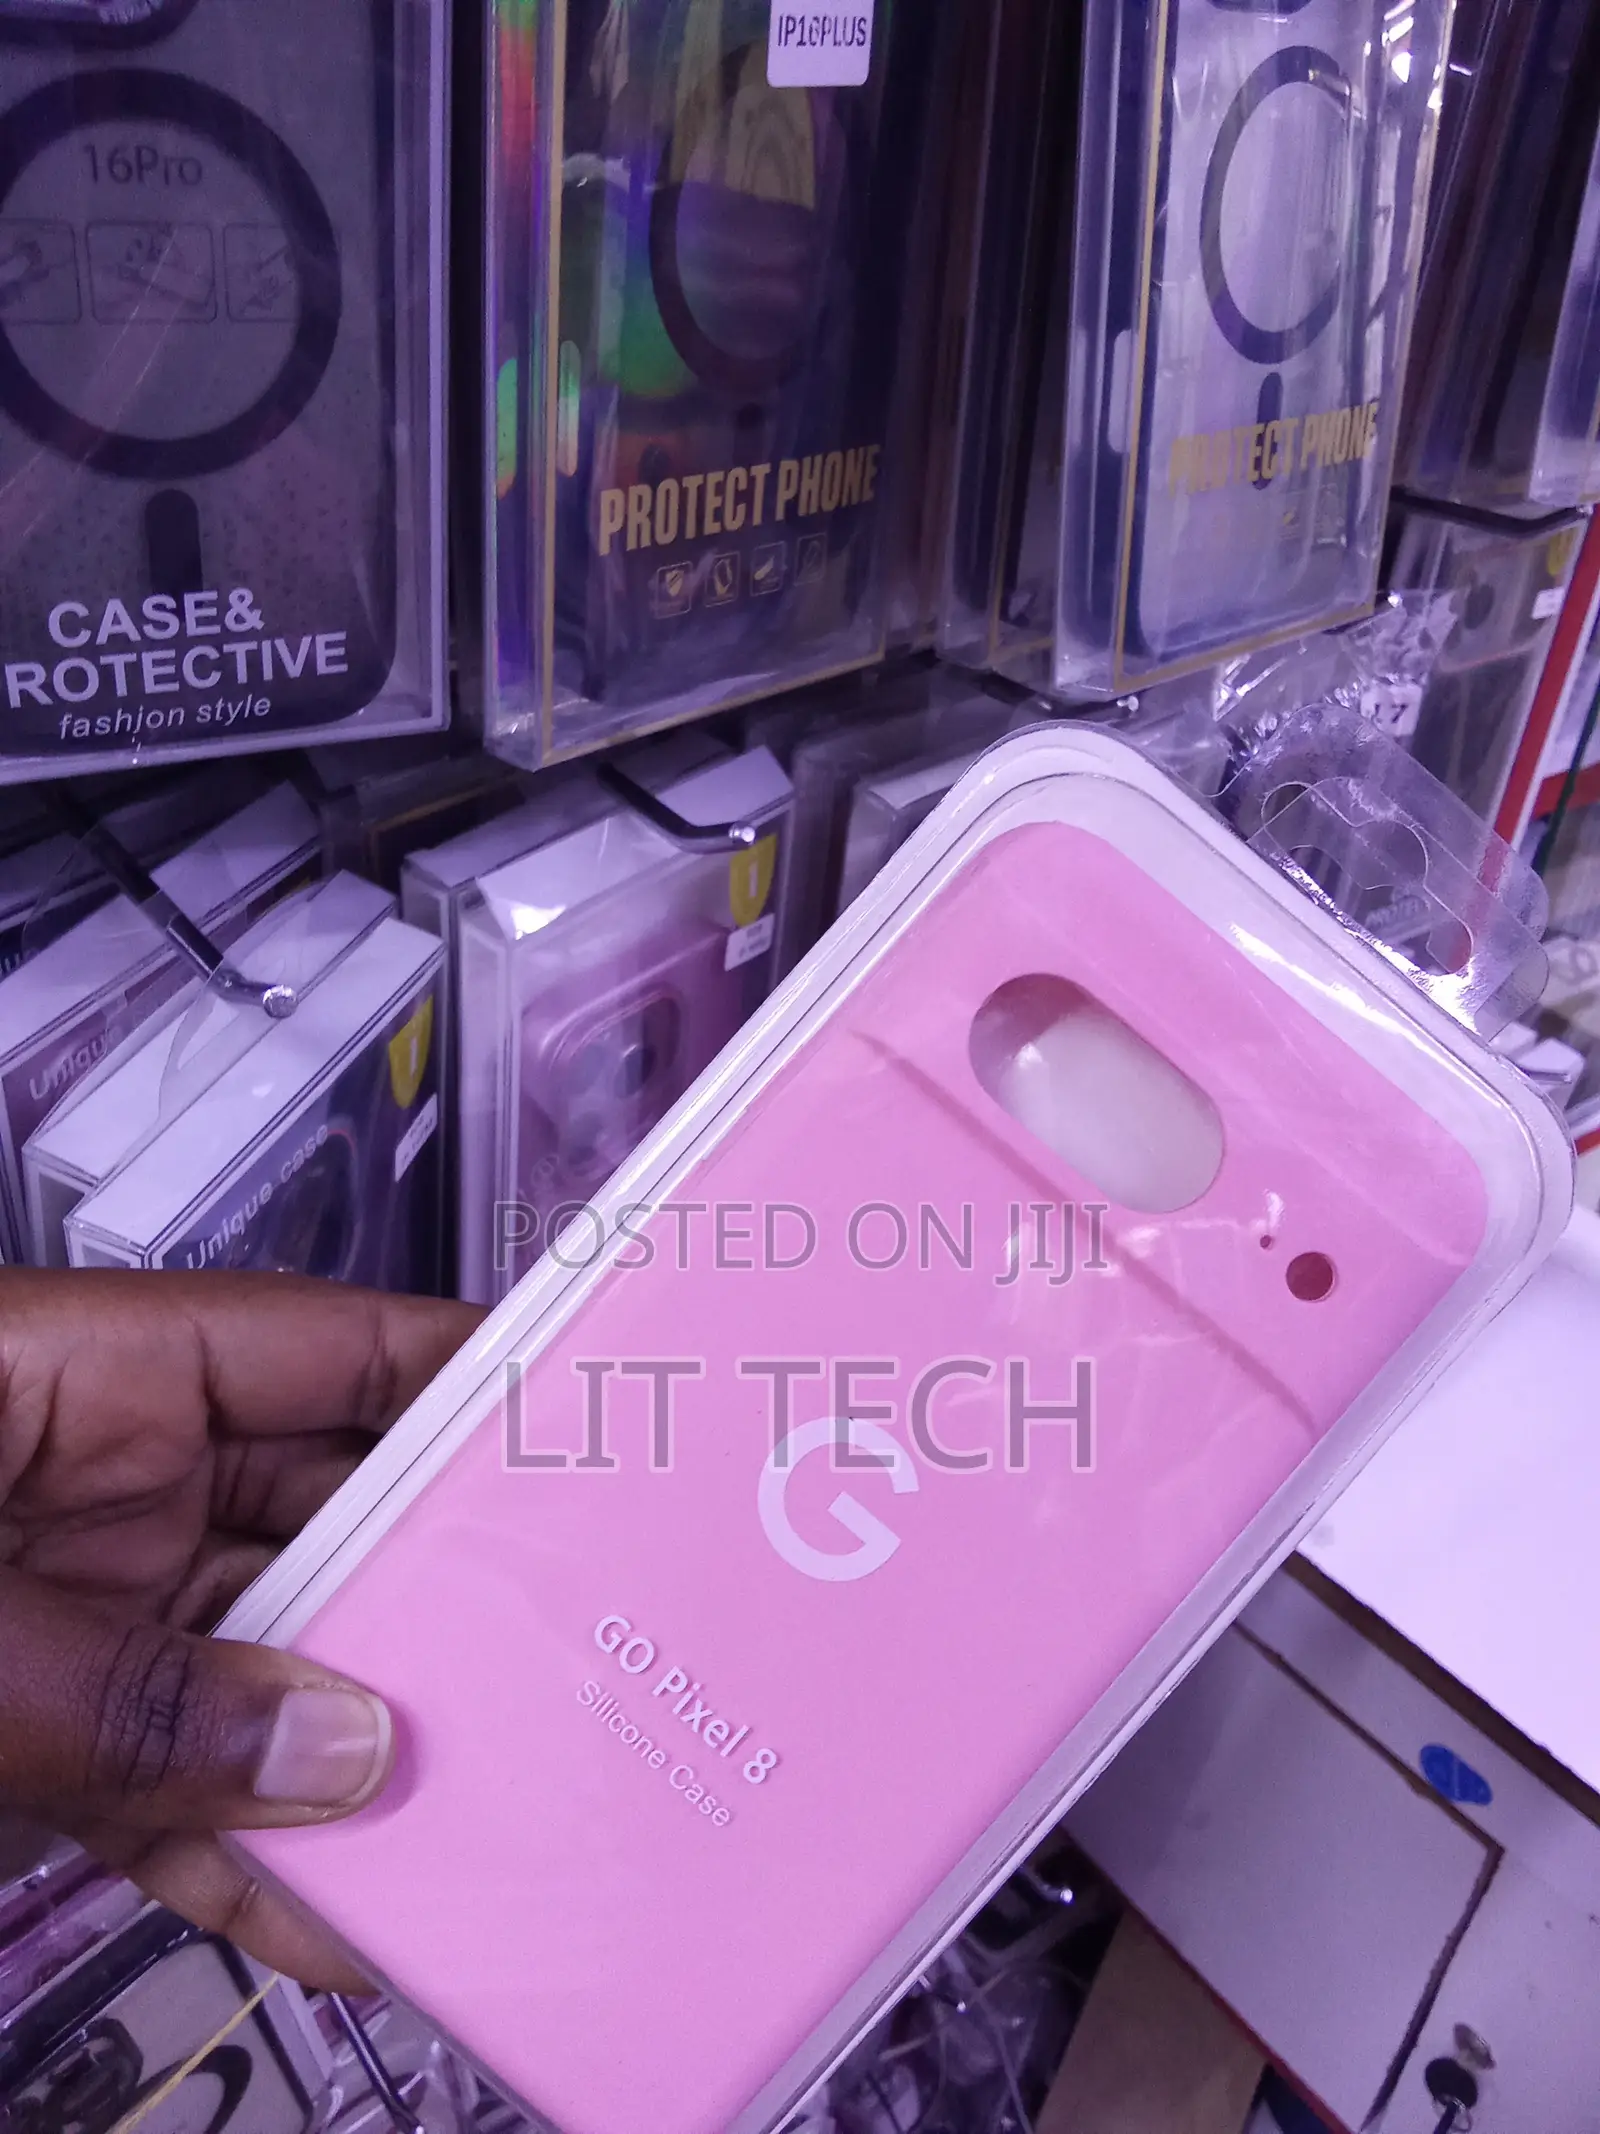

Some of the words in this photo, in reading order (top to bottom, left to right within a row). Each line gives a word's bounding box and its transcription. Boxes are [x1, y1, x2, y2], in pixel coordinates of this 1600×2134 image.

[84, 143, 203, 186] 16Pro
[1169, 417, 1299, 498] PROTECT
[1302, 402, 1379, 471] PHONE
[599, 462, 771, 557] PROTECT
[774, 443, 880, 521] PHONE
[47, 587, 265, 648] CASE&
[59, 703, 185, 740] fashion
[196, 693, 272, 726] style
[280, 1124, 328, 1184] case
[757, 1416, 920, 1582] G
[594, 1614, 656, 1675] GO
[651, 1665, 750, 1758] Pixel
[743, 1747, 778, 1785] 8
[576, 1680, 668, 1770] Silicone
[668, 1764, 731, 1827] Case
